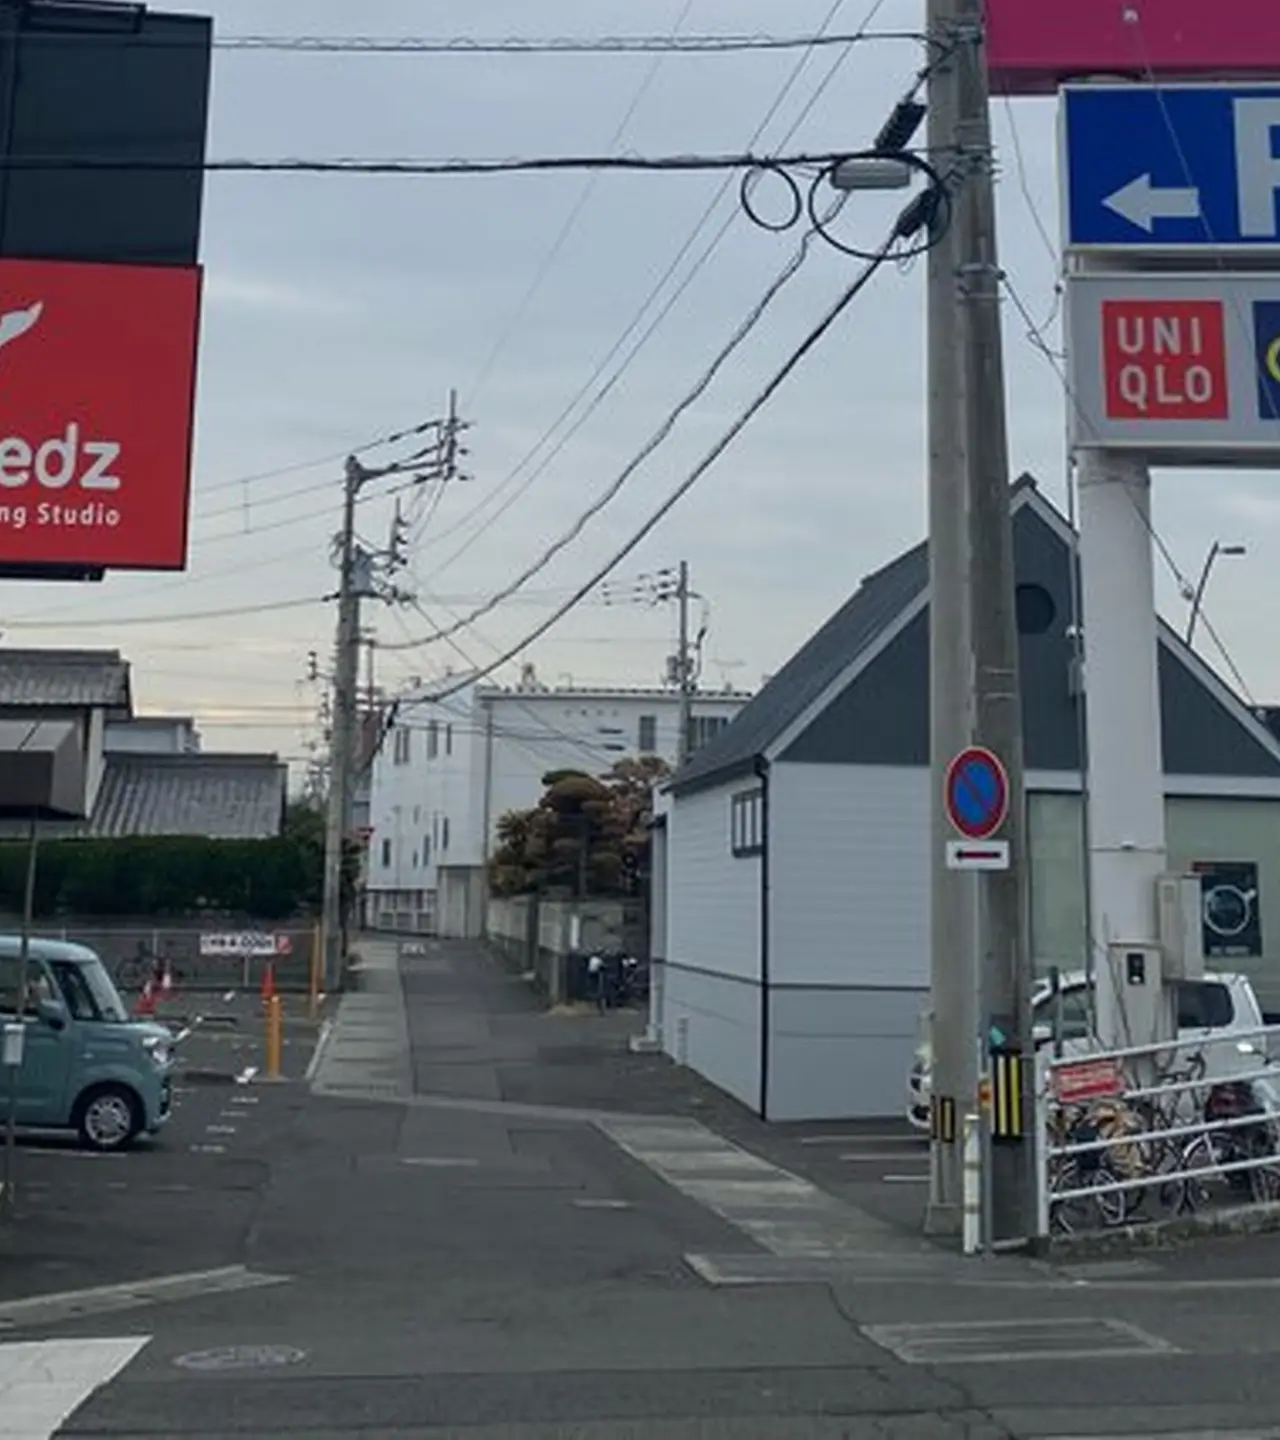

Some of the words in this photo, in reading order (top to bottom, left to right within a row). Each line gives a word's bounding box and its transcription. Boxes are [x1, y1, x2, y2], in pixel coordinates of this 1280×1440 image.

[1117, 316, 1202, 355] UNI
[1120, 365, 1213, 410] QLO
[37, 502, 121, 527] Studio
